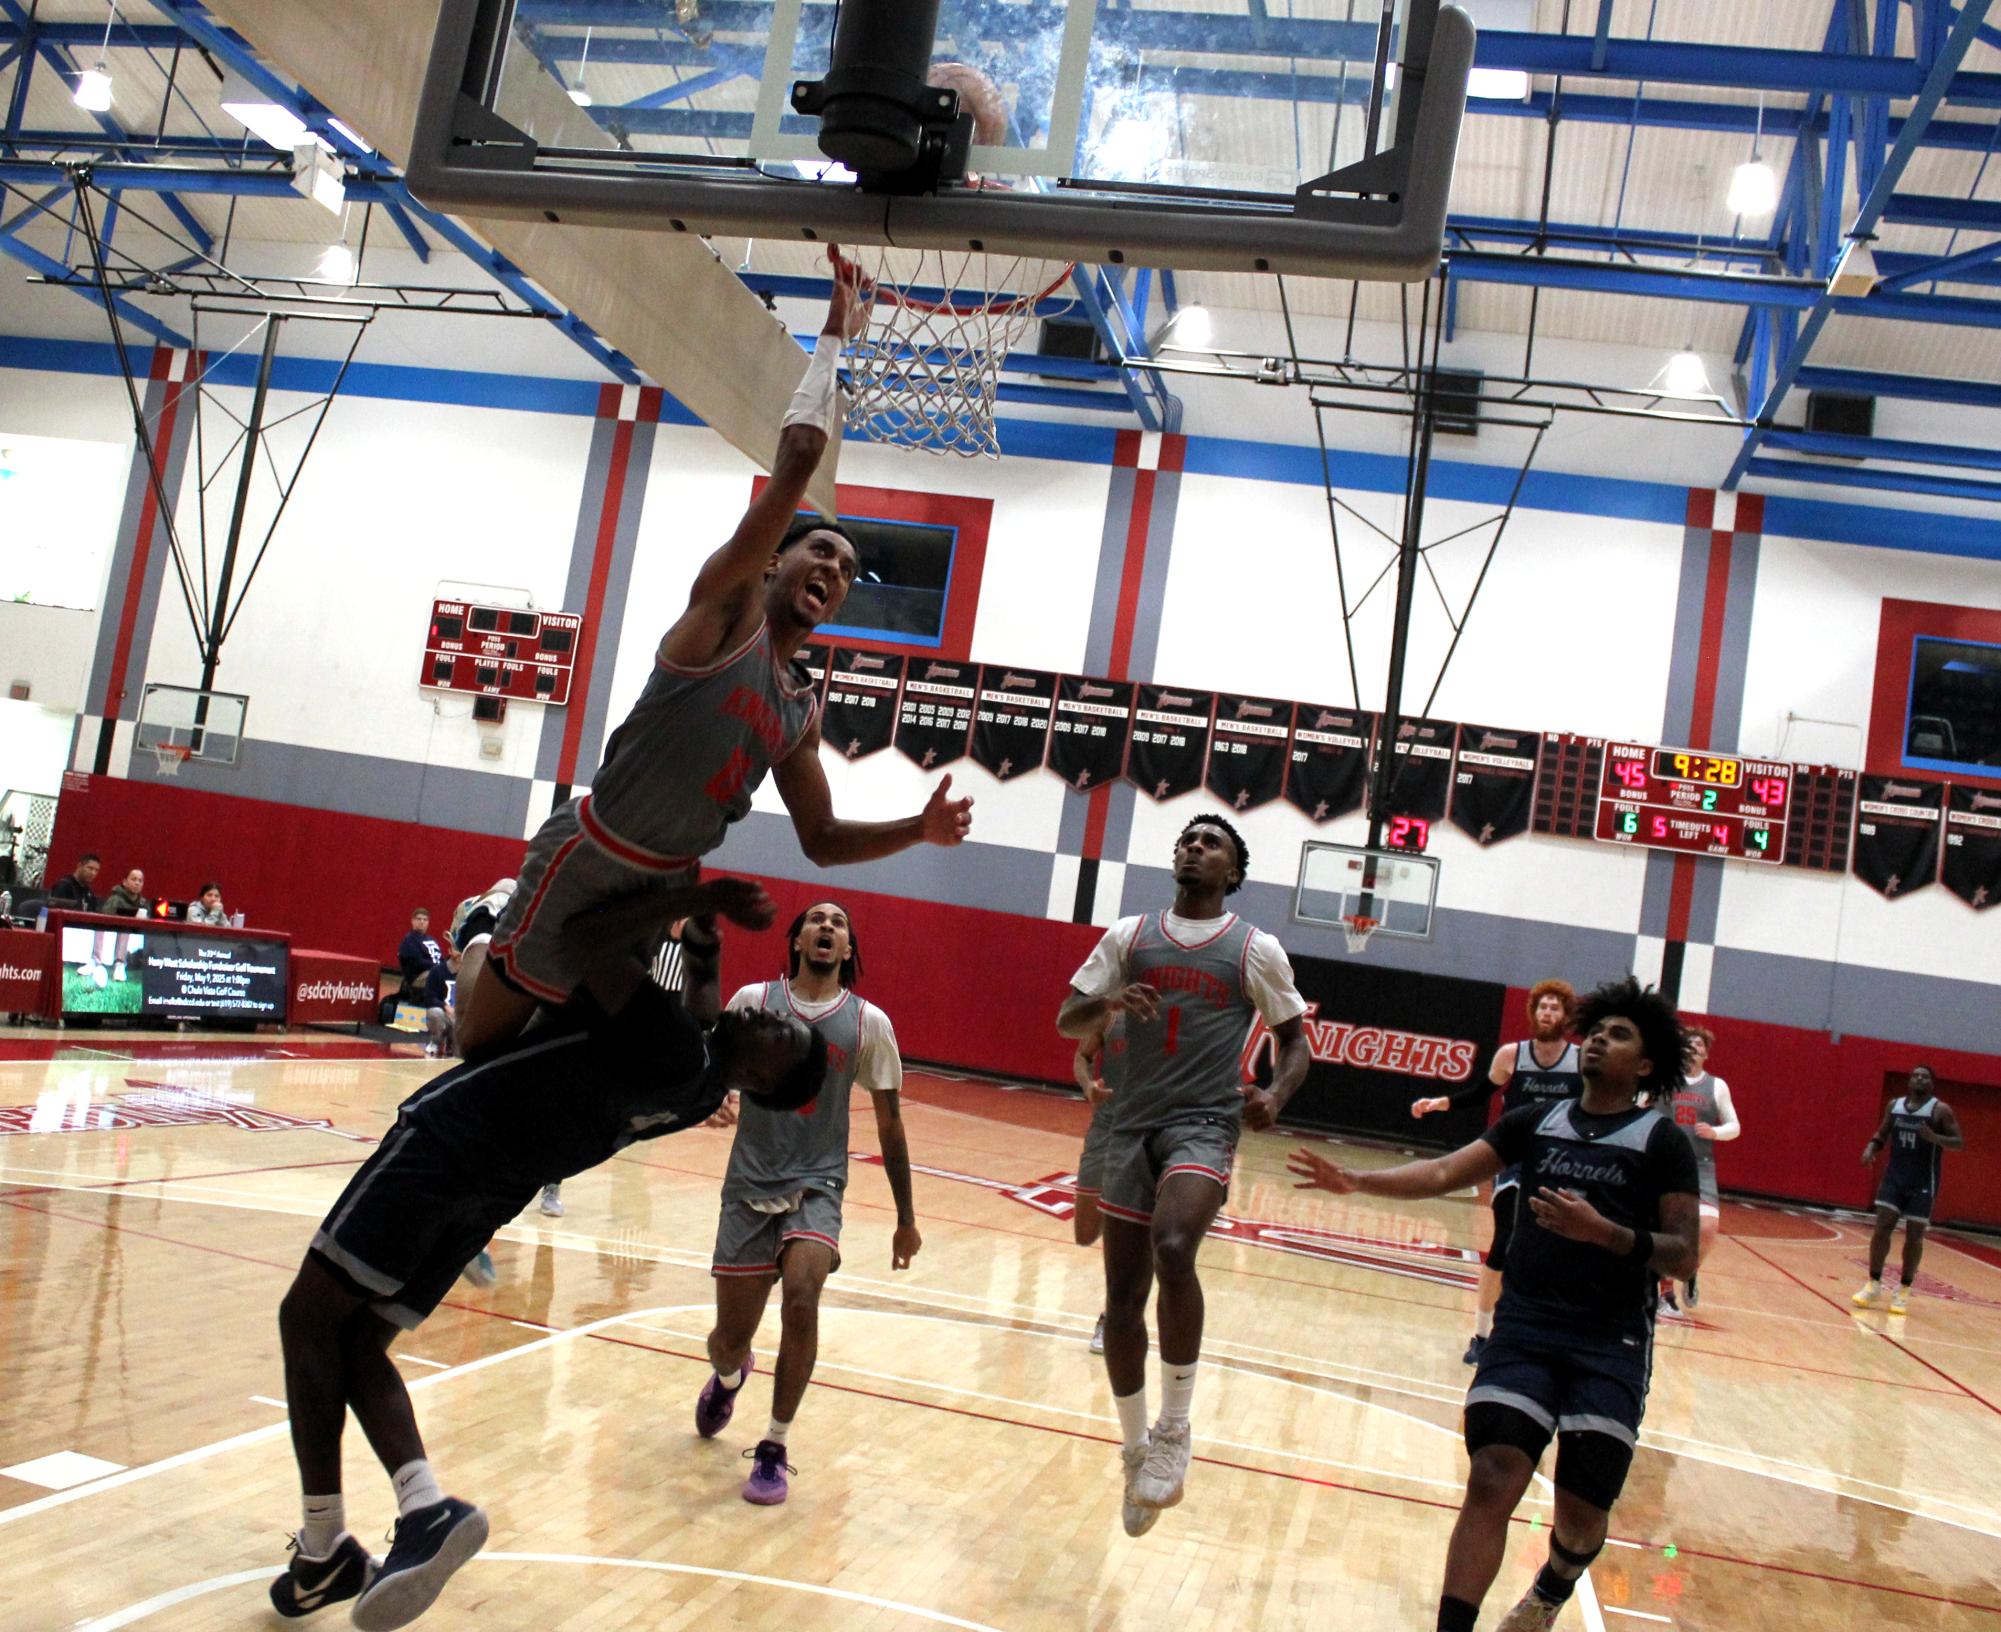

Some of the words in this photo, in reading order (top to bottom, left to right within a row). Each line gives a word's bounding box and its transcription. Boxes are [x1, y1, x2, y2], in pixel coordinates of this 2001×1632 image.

[438, 603, 464, 615] HOME
[542, 616, 578, 629] VISITOR
[441, 641, 463, 650] BONUS
[481, 641, 505, 651] PERIOD
[436, 654, 456, 663] FOULS
[535, 652, 558, 662] BONUS
[475, 658, 499, 668] PLAYER
[503, 662, 524, 672] FOULS
[537, 667, 558, 676] FOULS
[860, 676, 895, 688] BASKETBALL
[483, 685, 501, 693] GAME
[910, 682, 928, 690] MEN'S
[930, 685, 970, 697] BASKETBALL
[986, 692, 1004, 700] MEN'S
[1006, 695, 1045, 706] BASKETBALL
[1063, 702, 1082, 710] MEN'S
[1083, 705, 1123, 716] BASKETBALL
[936, 718, 951, 728] 2017
[996, 713, 1011, 724] 2017
[1141, 711, 1160, 720] MEN'S
[1161, 714, 1202, 726] BASKETBALL
[1073, 723, 1089, 734] 2017
[1221, 722, 1240, 730] MEN'S
[1242, 724, 1283, 736] BASKETBALL
[1152, 733, 1168, 744] 2017
[1297, 732, 1326, 742] WOMEN'S
[1328, 736, 1362, 747] VOLLEYBA
[1292, 750, 1308, 762] 2017
[1413, 746, 1450, 757] OLLEYBALL
[1613, 746, 1646, 760] HOME
[1615, 761, 1646, 787] 45
[1674, 754, 1737, 784] 9:28
[1745, 762, 1789, 778] VISITOR
[1620, 789, 1648, 800] BONUS
[1670, 790, 1700, 802] PERIOD
[1752, 779, 1786, 805] 43
[1702, 790, 1718, 811] 2
[1614, 803, 1640, 813] FOULS
[1739, 804, 1767, 816] BONUS
[1624, 813, 1638, 833] 6
[1652, 816, 1667, 837] 5
[1670, 820, 1711, 833] TIMEOUTS
[1744, 820, 1769, 830] FOULS
[1390, 816, 1429, 848] 27
[1679, 830, 1699, 840] LEFT
[1713, 825, 1728, 845] 4
[1754, 830, 1769, 850] 4
[1708, 846, 1729, 854] GAME
[235, 962, 247, 973] Golf
[194, 972, 207, 985] May
[216, 986, 228, 996] Golf
[227, 987, 246, 997] Course
[297, 981, 374, 1005] @sdcityknights
[1164, 1004, 1182, 1055] 1
[1899, 1130, 1916, 1150] 44
[1536, 1147, 1627, 1185] Hornets
